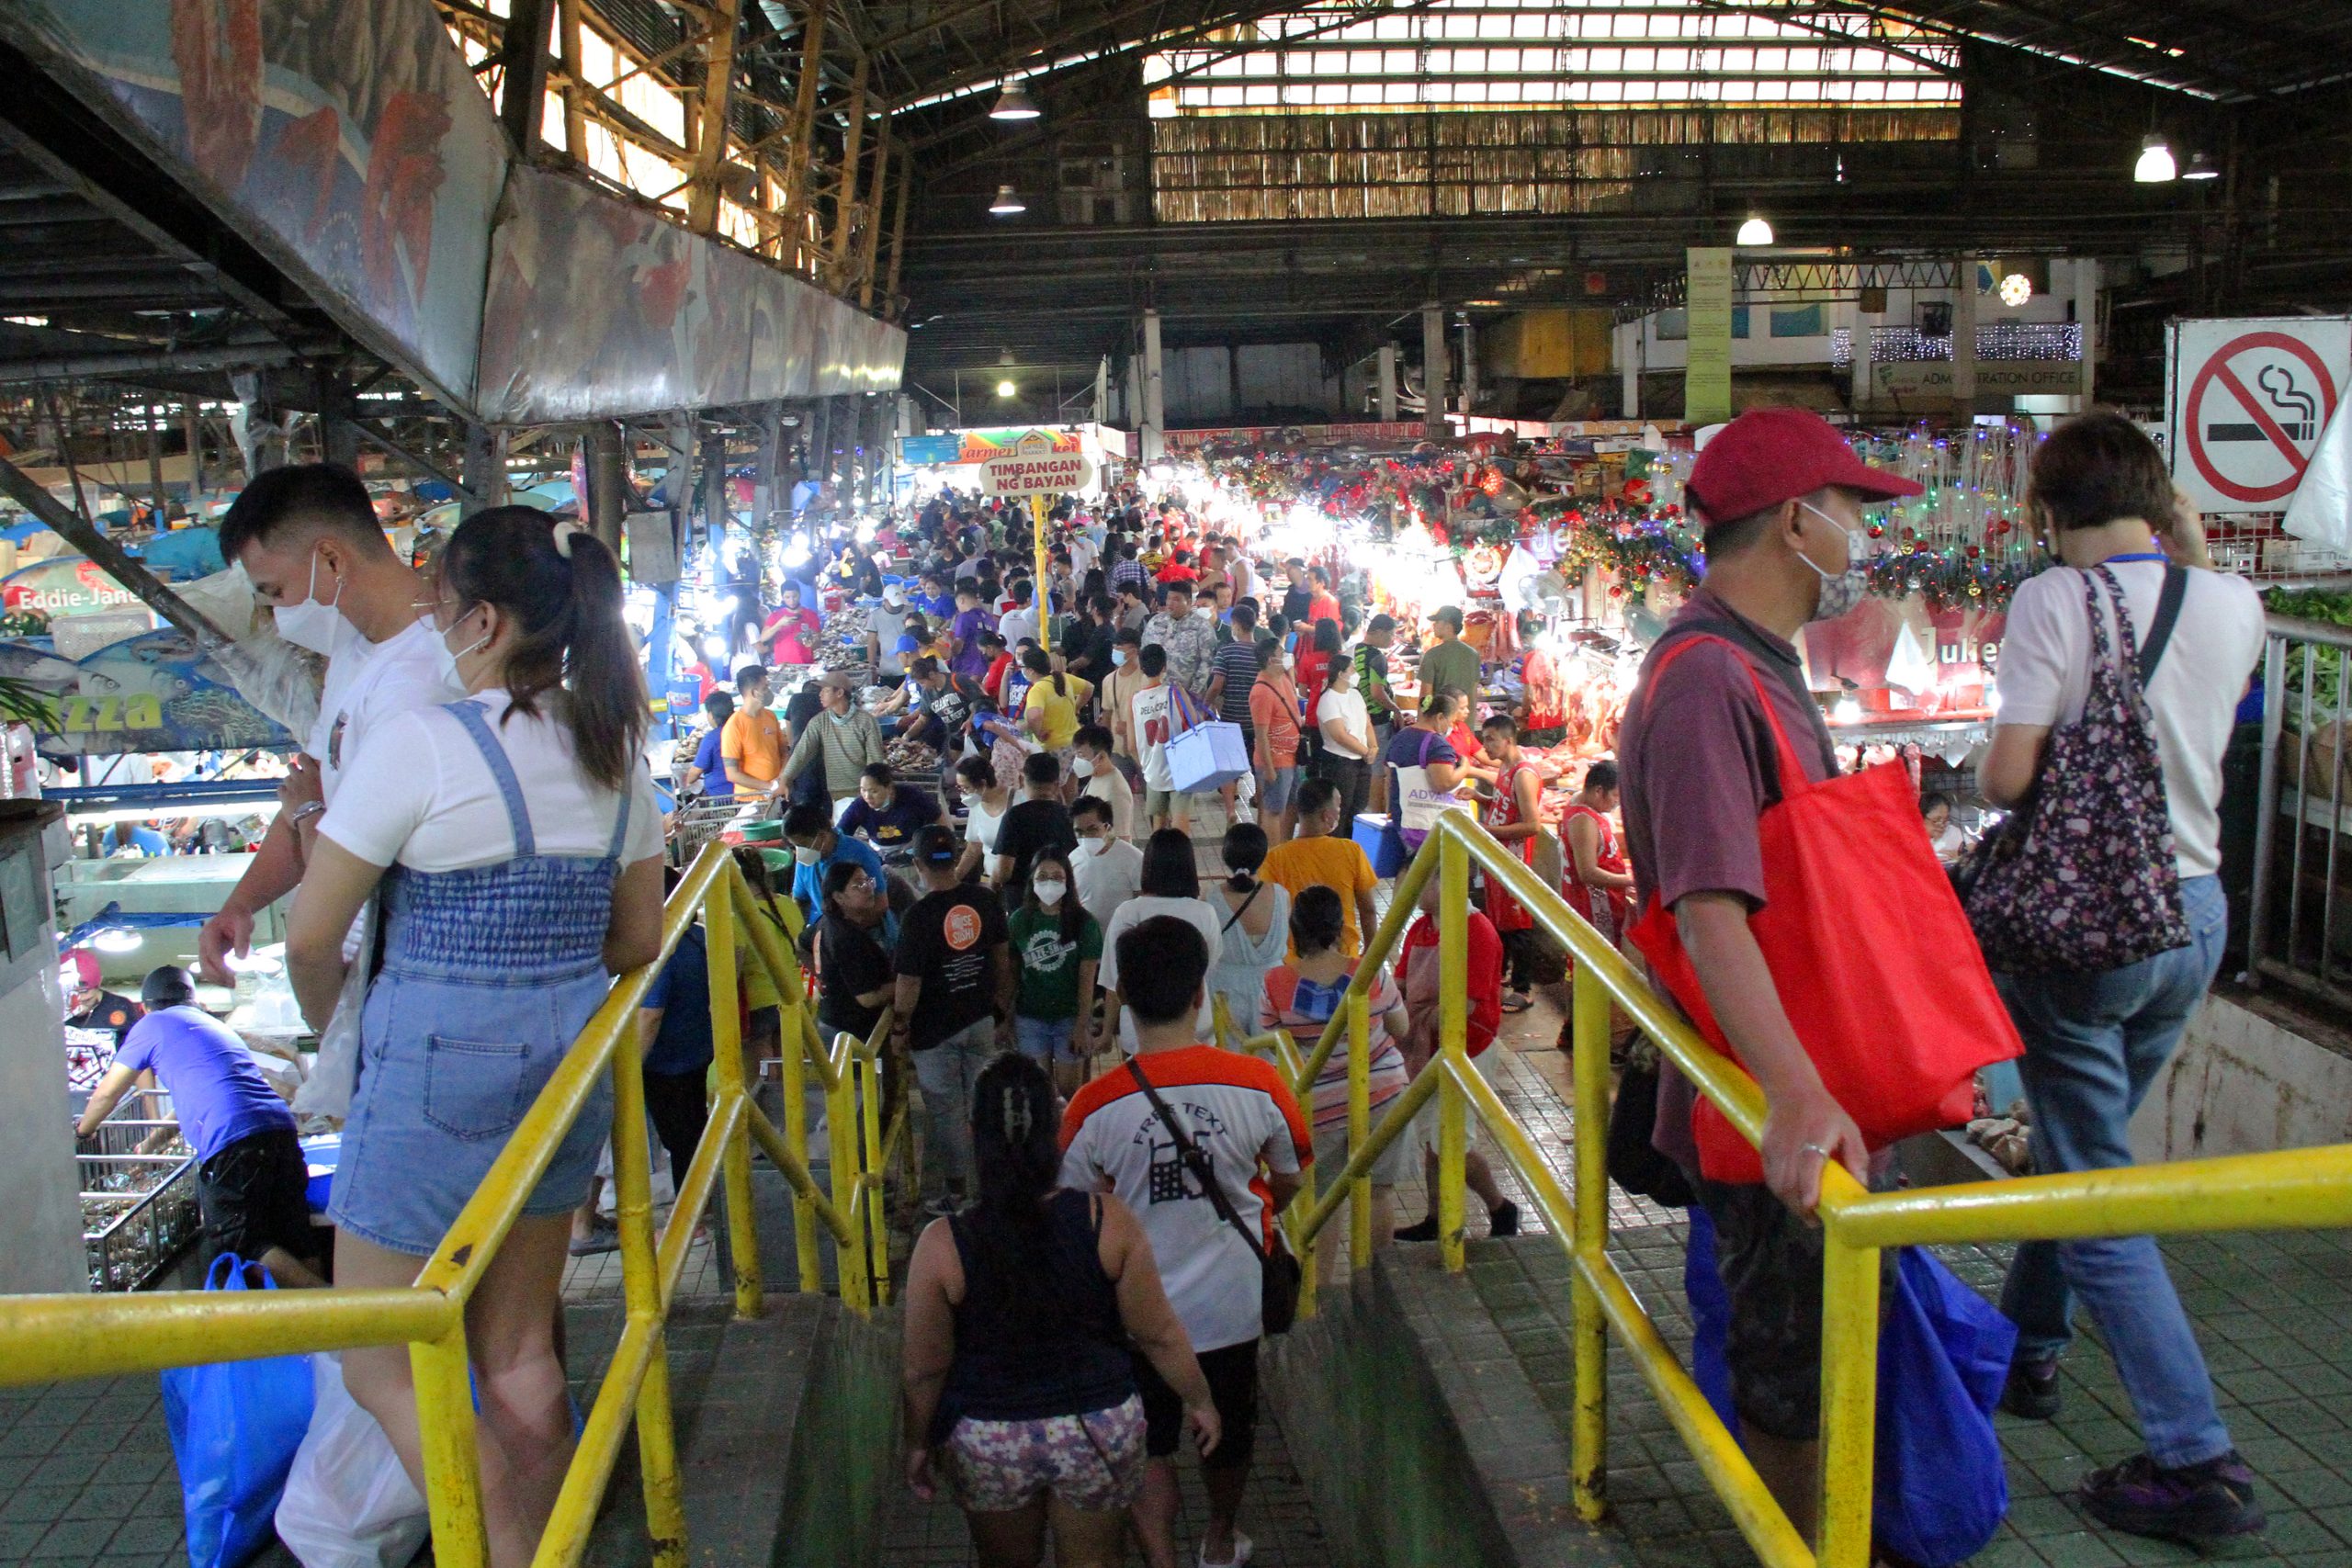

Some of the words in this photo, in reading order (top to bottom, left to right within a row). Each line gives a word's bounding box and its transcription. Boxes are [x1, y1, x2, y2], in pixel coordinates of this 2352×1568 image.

[1922, 372, 2028, 385] ADMTRATION
[2031, 371, 2075, 384] OFFICE
[1053, 440, 1076, 453] ket
[989, 459, 1082, 477] TIMBANGAN
[997, 478, 1021, 491] NG
[1023, 473, 1077, 488] BAYAN
[1182, 1101, 1228, 1136] TEXT
